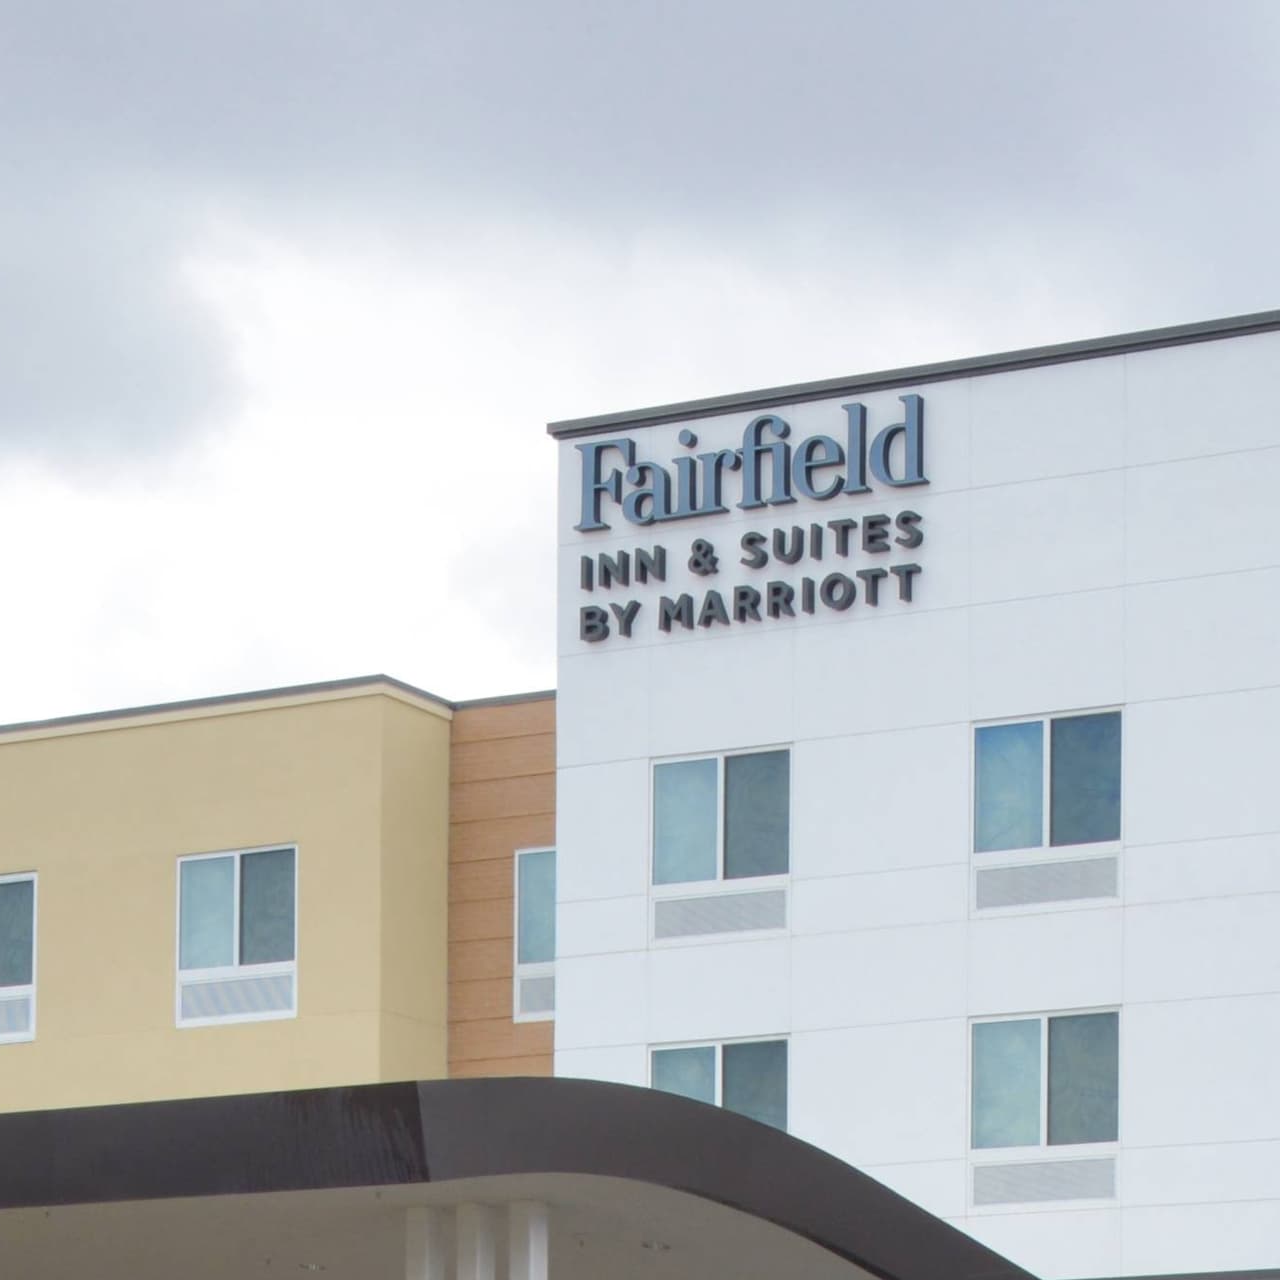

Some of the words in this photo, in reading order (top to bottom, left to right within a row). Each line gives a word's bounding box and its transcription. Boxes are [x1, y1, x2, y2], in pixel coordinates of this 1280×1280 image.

[573, 393, 930, 533] Fairfield
[580, 544, 667, 592] INN
[687, 538, 719, 576] &
[740, 510, 924, 570] SUITES
[580, 599, 642, 643] BY
[658, 563, 922, 633] MARRIOTT
